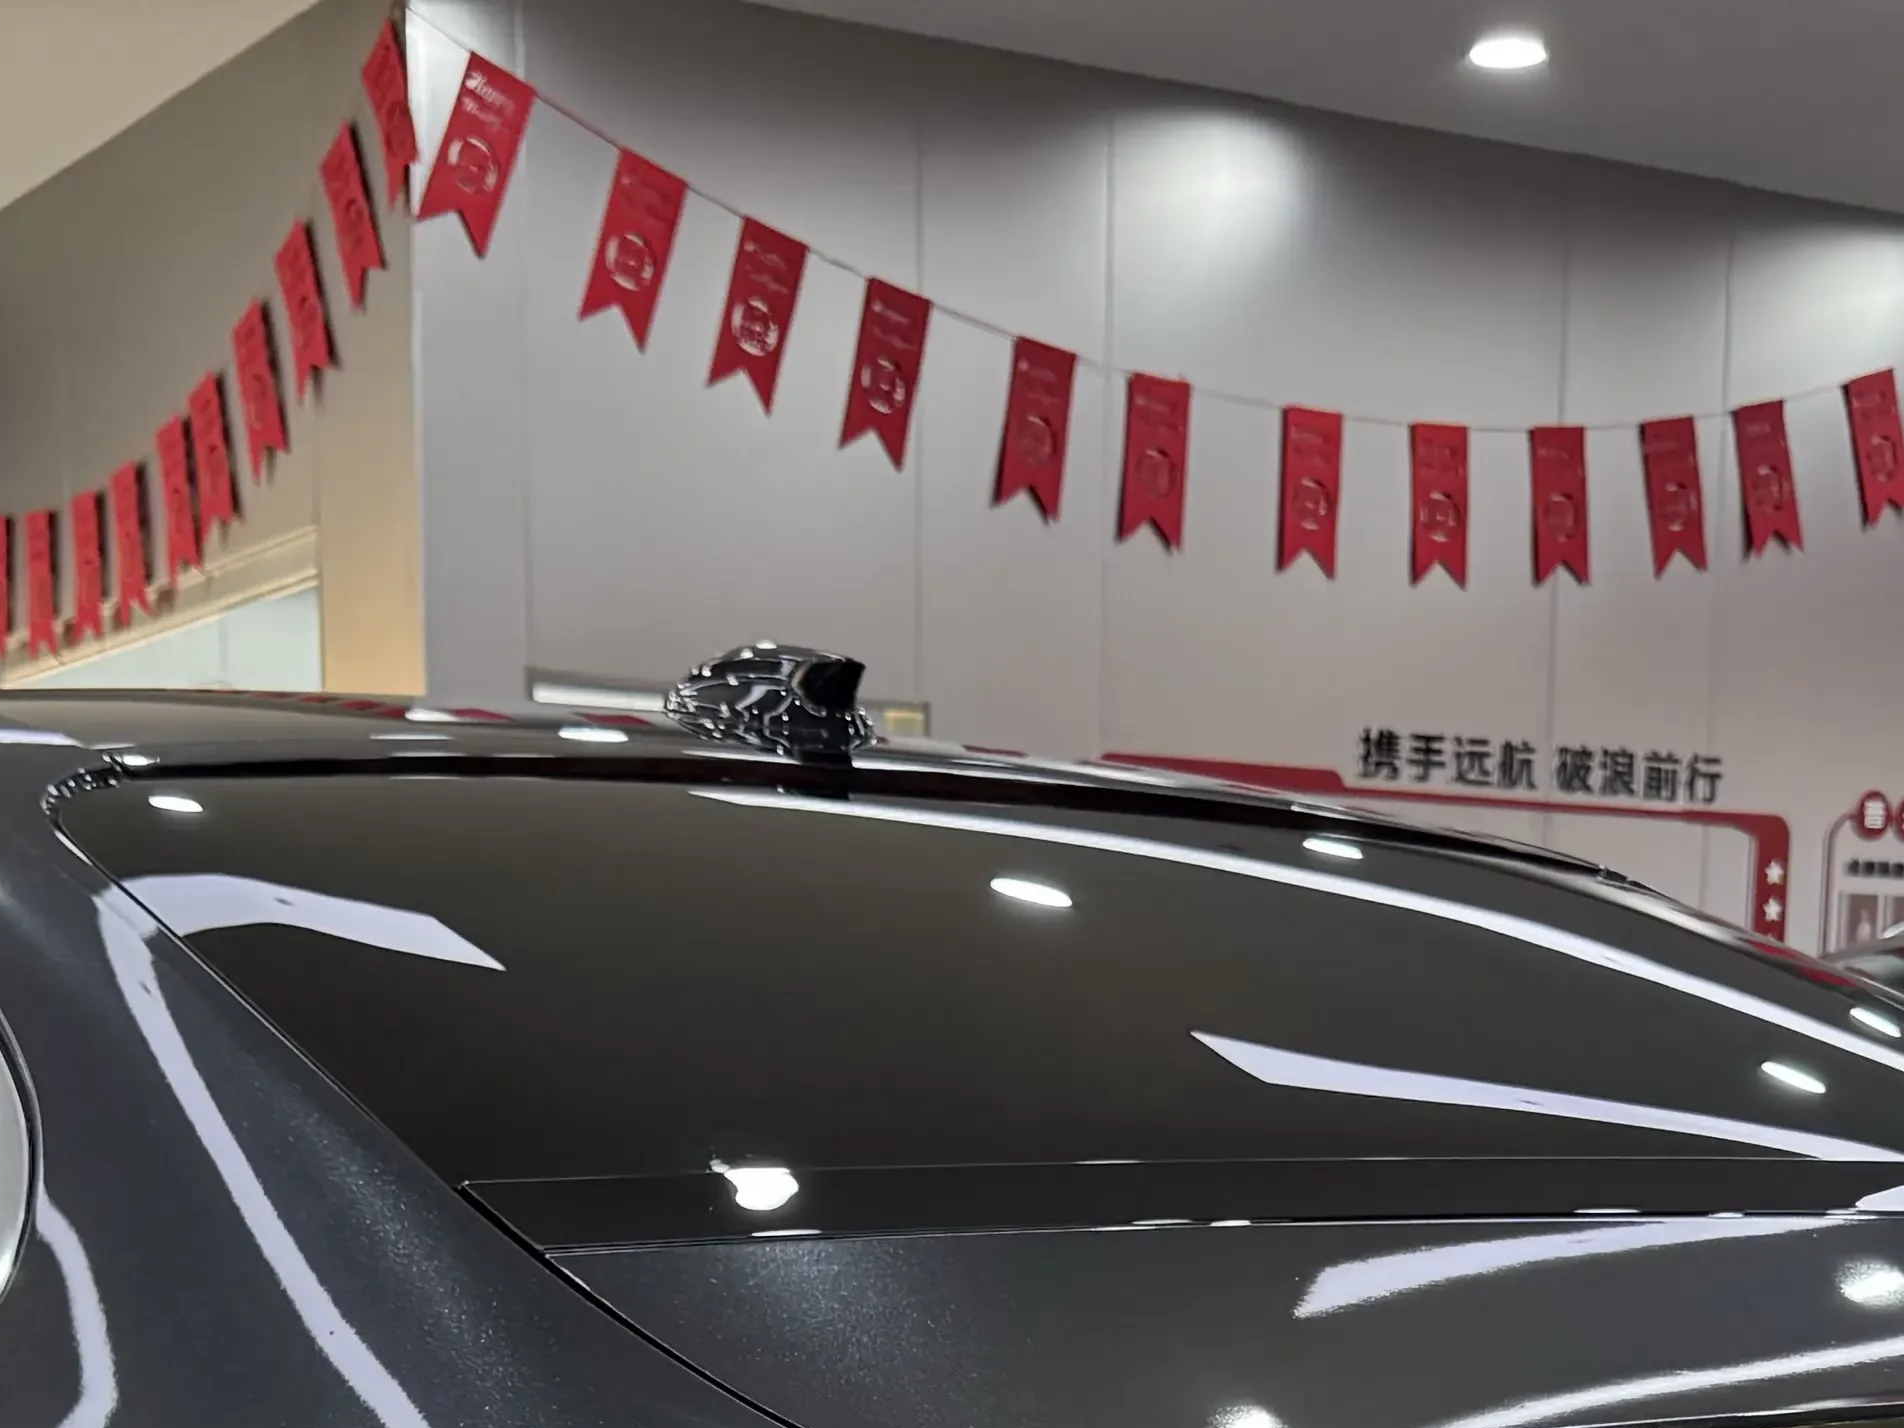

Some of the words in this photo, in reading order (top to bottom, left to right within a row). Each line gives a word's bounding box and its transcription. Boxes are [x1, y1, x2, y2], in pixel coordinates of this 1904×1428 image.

[1358, 728, 1538, 791] 携手远航
[1554, 743, 1724, 805] 破浪前行
